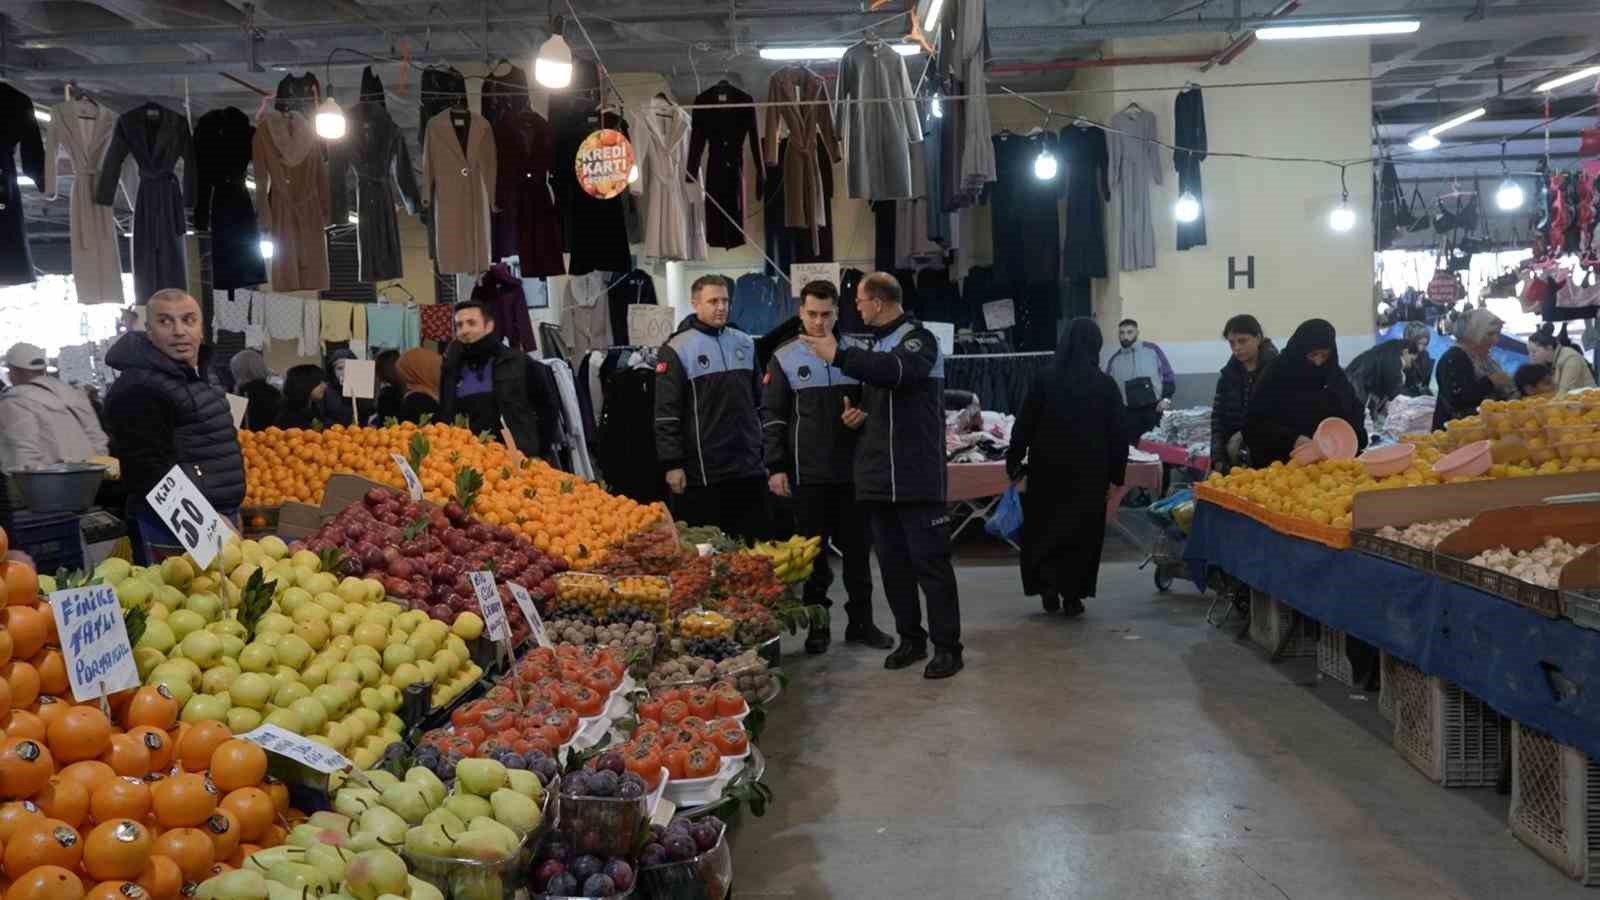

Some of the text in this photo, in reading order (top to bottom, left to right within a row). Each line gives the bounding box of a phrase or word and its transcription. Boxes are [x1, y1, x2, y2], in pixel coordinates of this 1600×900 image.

[582, 142, 626, 162] KREDİ
[582, 158, 626, 176] KARTI
[1228, 255, 1254, 289] H
[170, 497, 204, 549] 50
